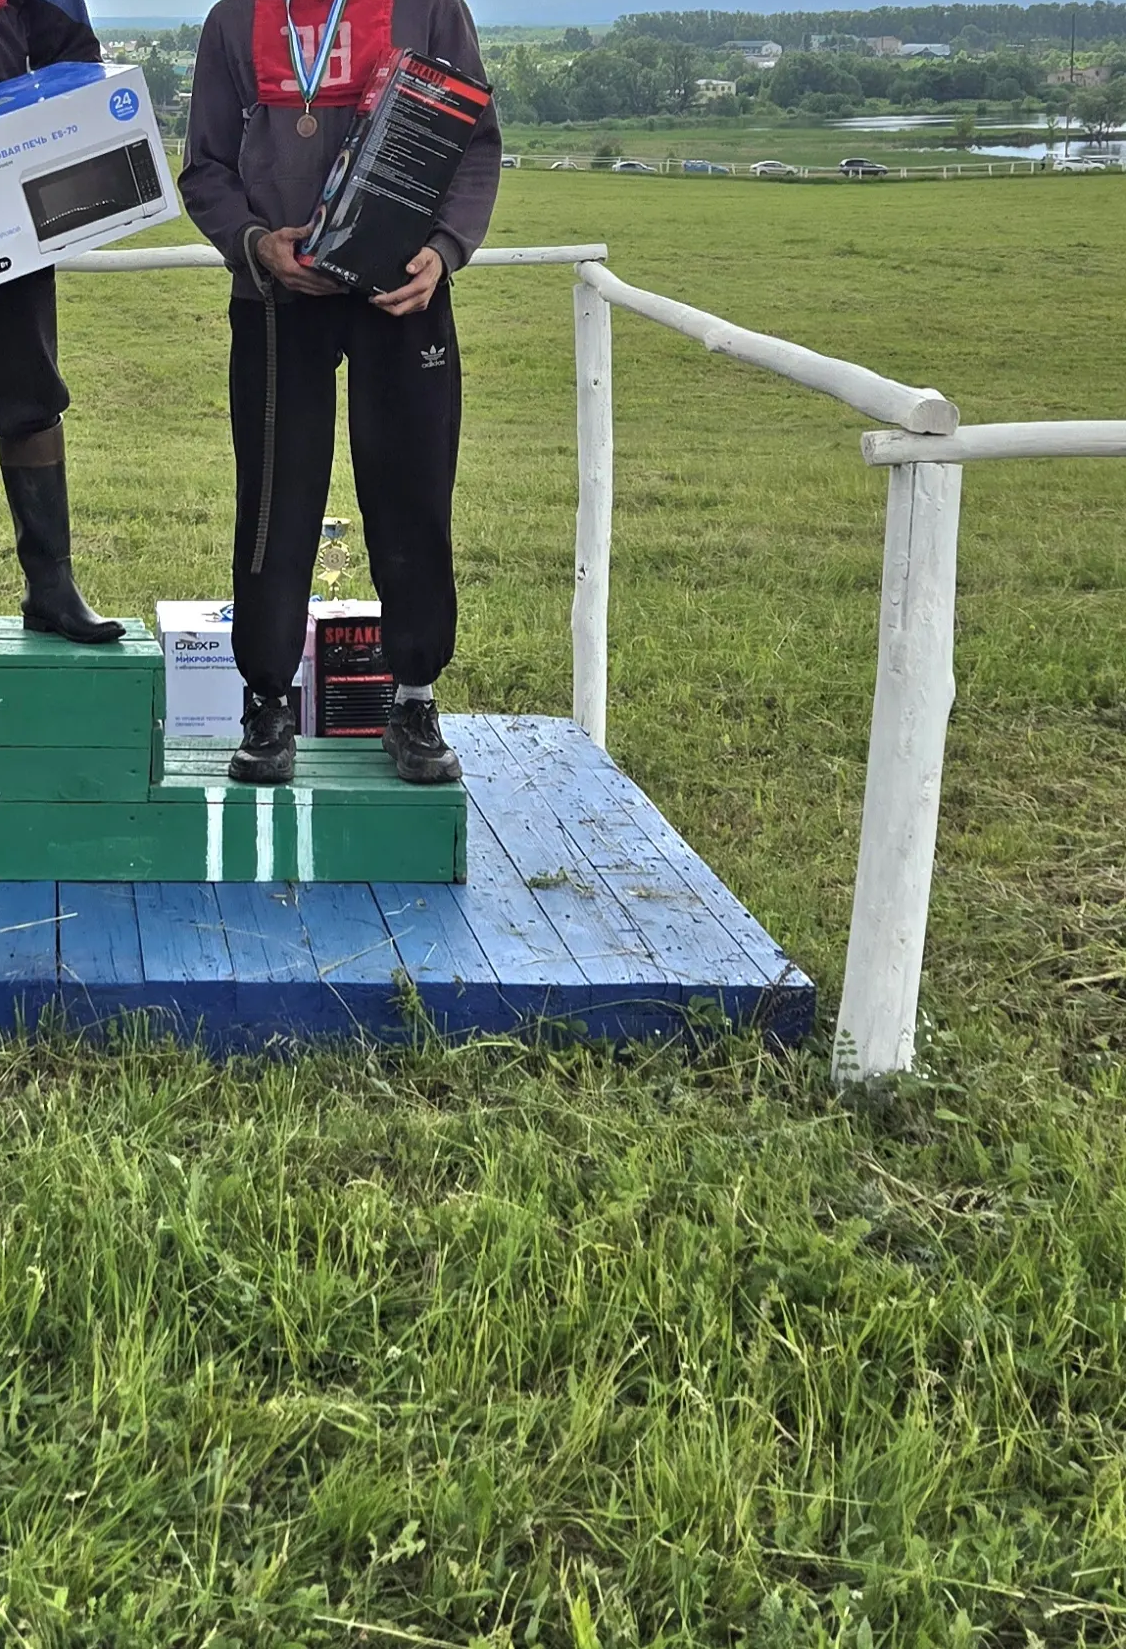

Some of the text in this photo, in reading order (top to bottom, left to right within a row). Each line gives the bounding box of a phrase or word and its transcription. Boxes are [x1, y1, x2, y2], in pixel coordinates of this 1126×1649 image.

[113, 92, 132, 109] 24
[22, 136, 48, 152] ПЕЧЬ
[51, 125, 78, 141] ES-70
[330, 553, 340, 563] 3
[325, 626, 382, 644] SPEAKE
[204, 786, 315, 882] III
